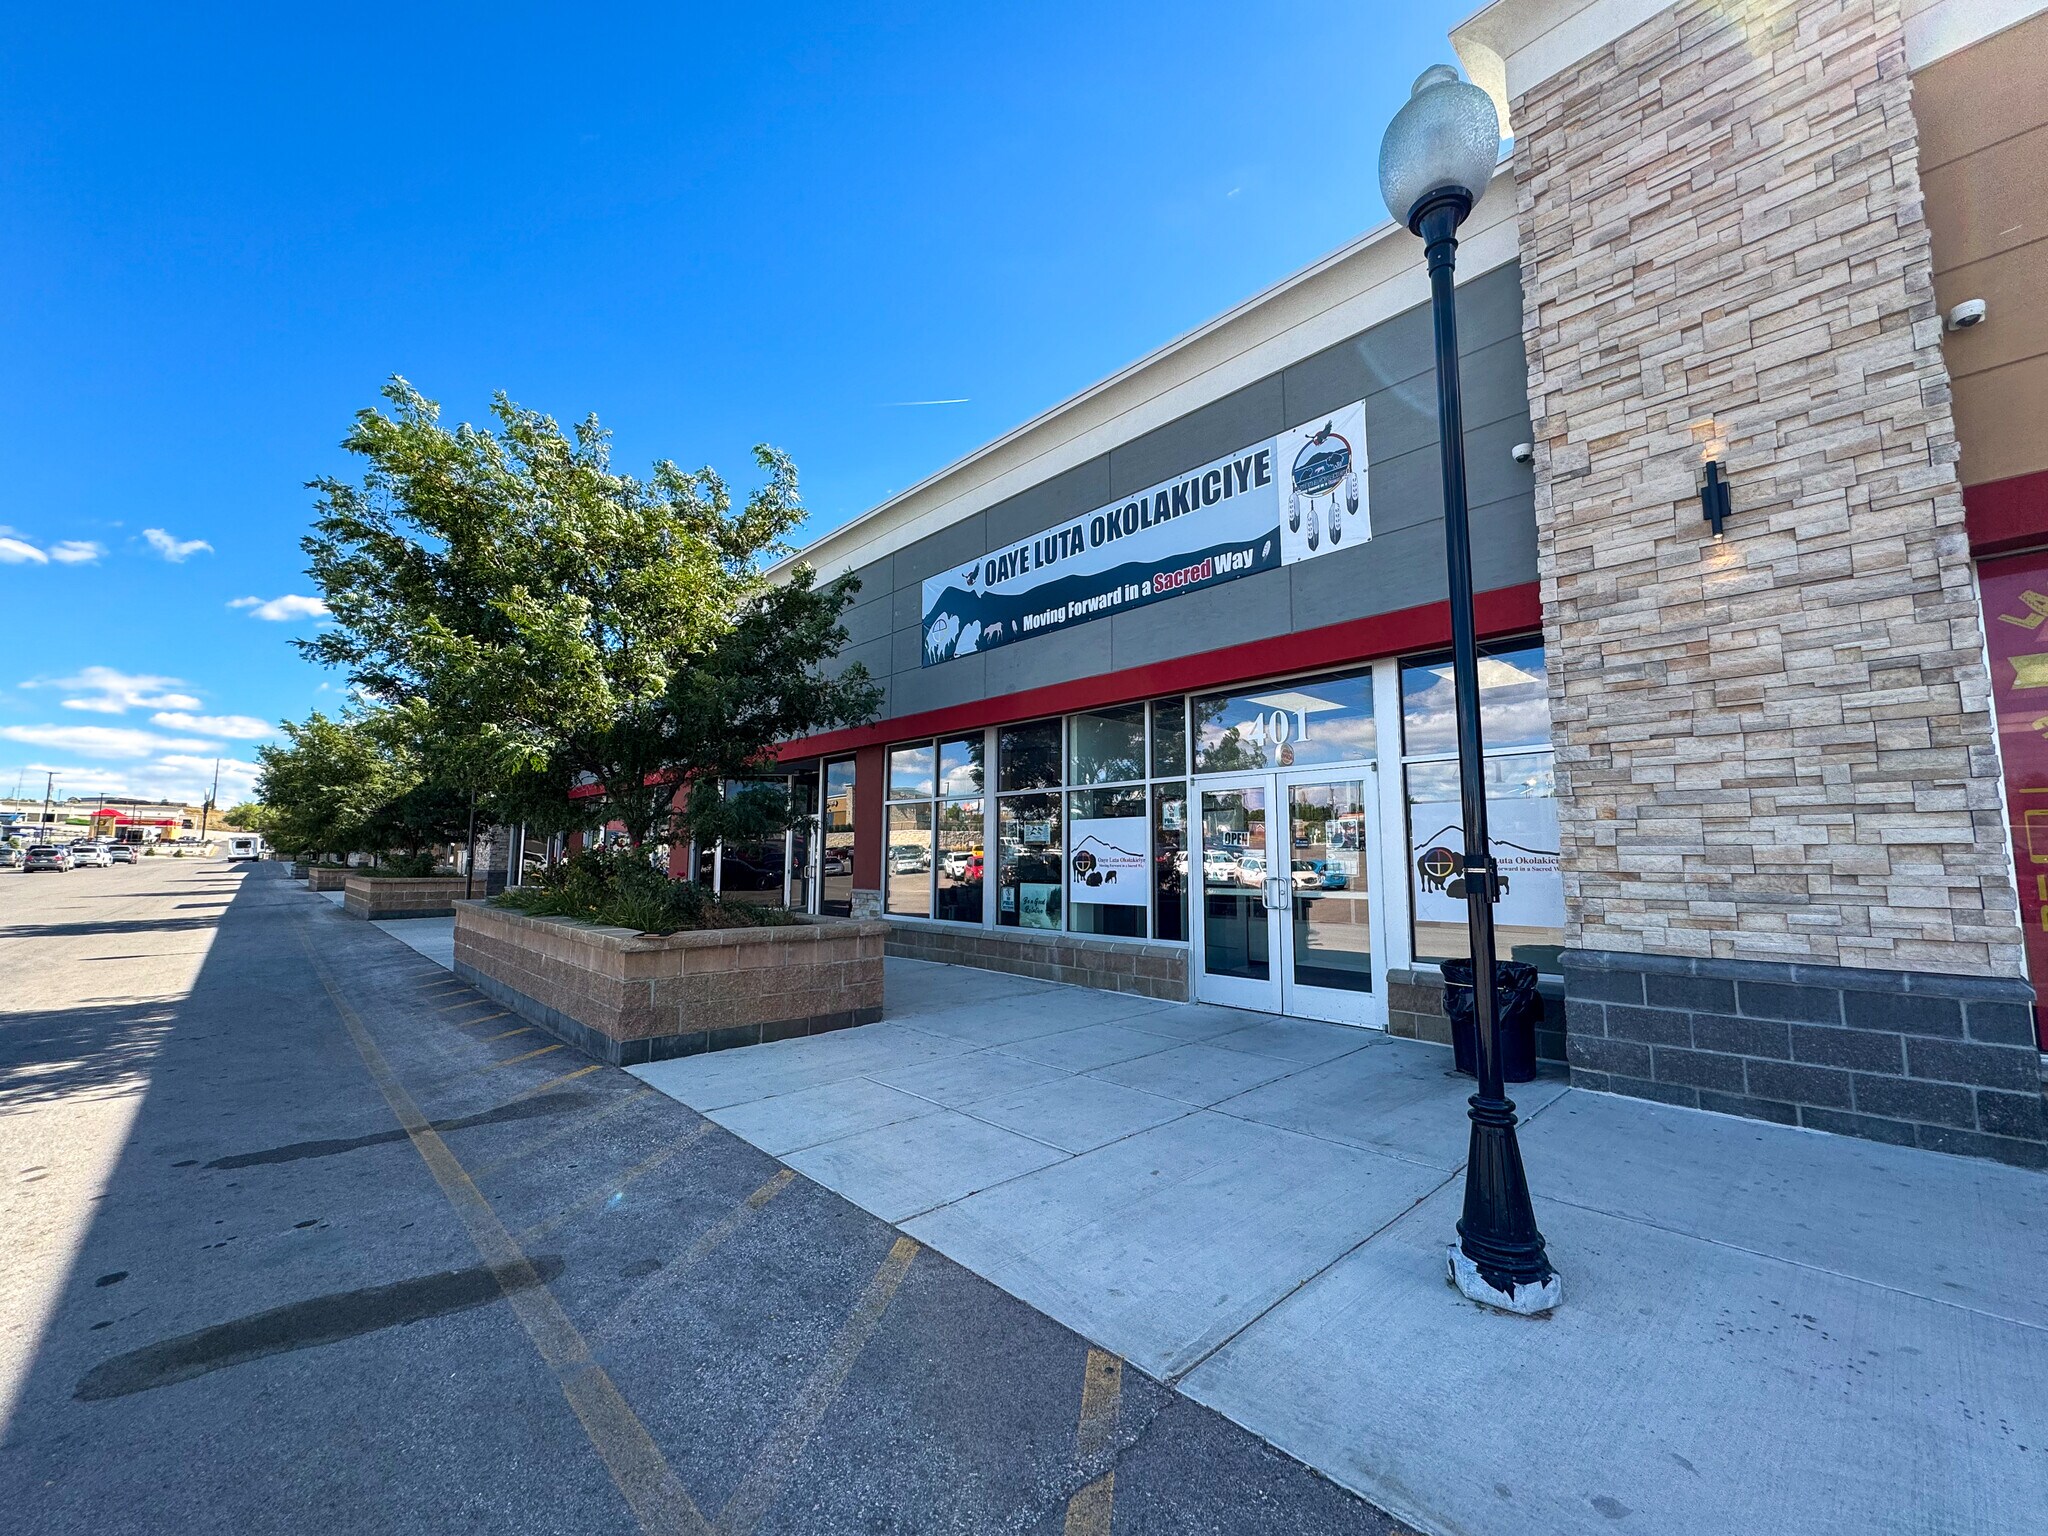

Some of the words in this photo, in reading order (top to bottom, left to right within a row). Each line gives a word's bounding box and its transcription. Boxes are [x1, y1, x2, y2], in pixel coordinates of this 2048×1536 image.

[984, 544, 1030, 587] OAYE
[1034, 523, 1085, 570] LUTA
[1089, 448, 1272, 548] OKOLAKICIYE
[1023, 609, 1066, 632] Moving
[1068, 586, 1122, 618] Forward
[1124, 584, 1139, 602] in
[1142, 580, 1151, 597] a
[1153, 557, 1212, 593] Sacred
[1214, 548, 1254, 575] Way
[1247, 706, 1312, 747] 401
[1224, 832, 1248, 845] OPEN
[1515, 856, 1559, 865] Okolakici
